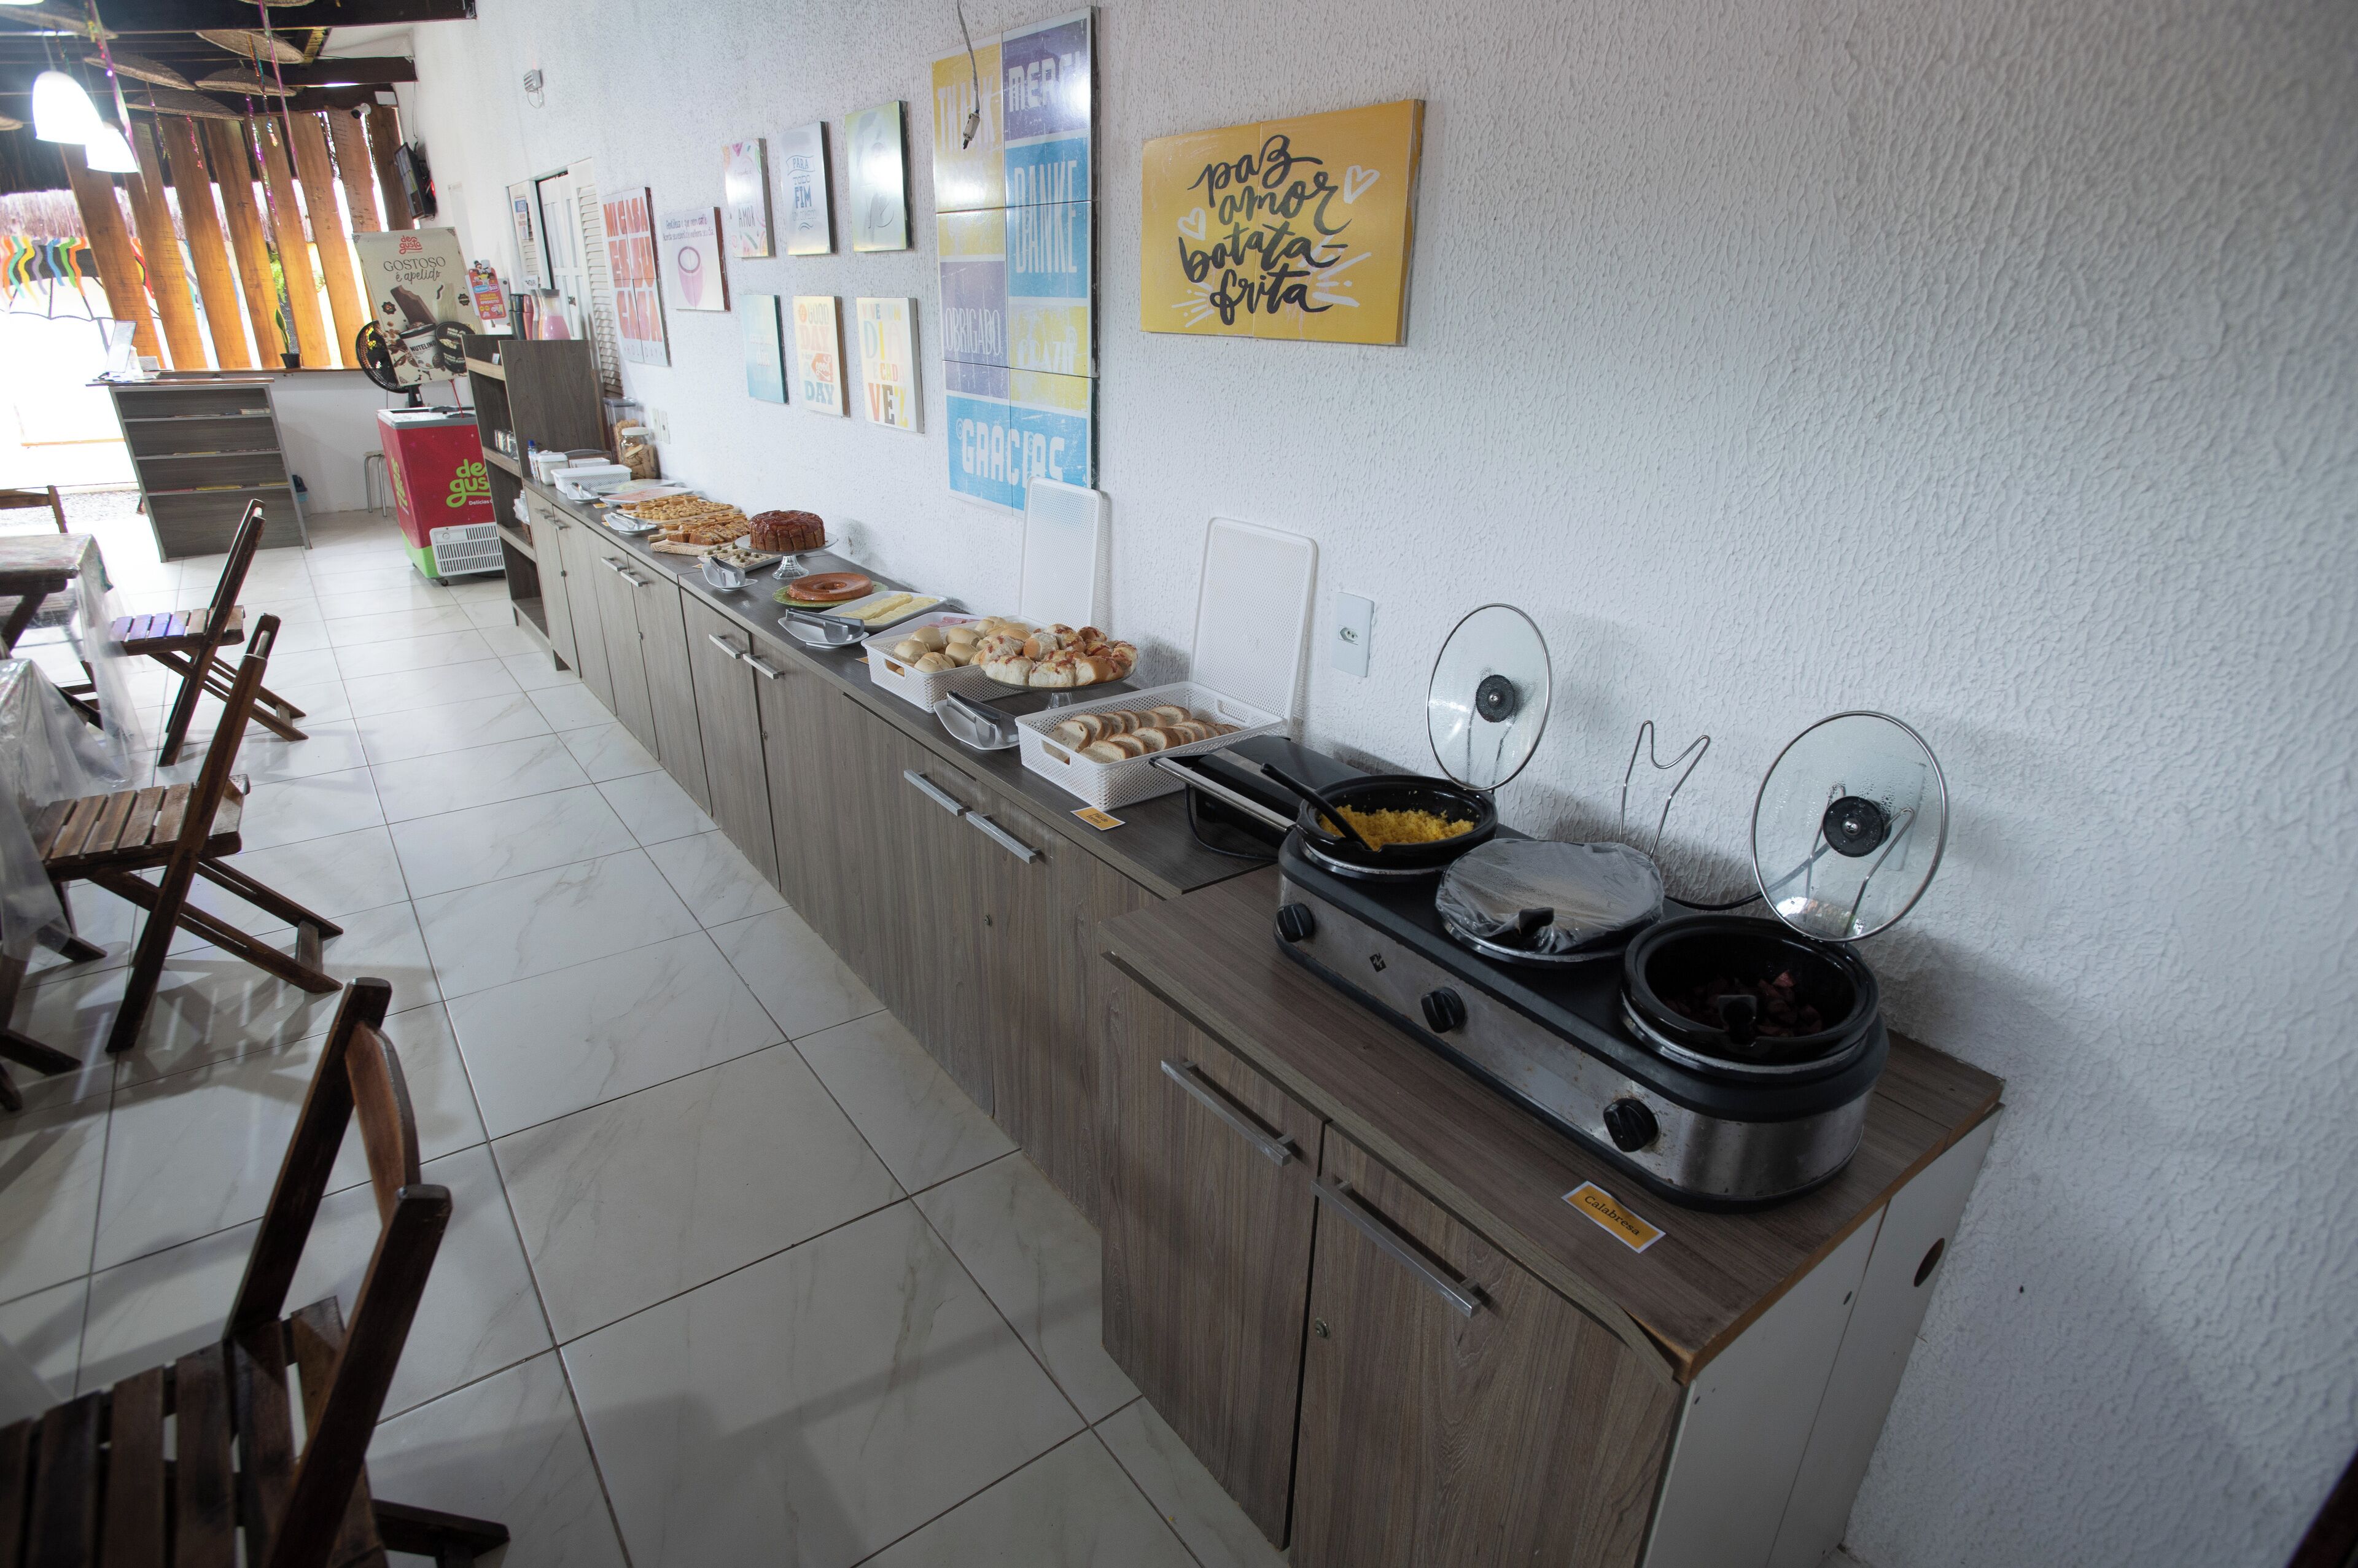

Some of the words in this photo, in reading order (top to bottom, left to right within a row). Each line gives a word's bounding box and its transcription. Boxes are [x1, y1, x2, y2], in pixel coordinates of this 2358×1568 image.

[792, 157, 809, 169] PARA
[792, 174, 811, 185] TODO
[1188, 134, 1323, 208] paz
[794, 185, 812, 209] FIM
[1219, 171, 1352, 236] amor
[617, 196, 649, 235] CASA
[738, 205, 756, 228] AMOR
[1014, 160, 1078, 274] DANKE
[383, 256, 446, 272] GOSTOSO
[395, 271, 402, 282] é
[404, 268, 442, 285] apelido
[1210, 263, 1334, 326] frita
[616, 290, 663, 343] CASA
[807, 303, 830, 325] GOOD
[945, 307, 1002, 356] OBRIGADO
[799, 324, 830, 352] DAY
[863, 320, 905, 363] DIA
[804, 380, 835, 405] DAY
[868, 382, 909, 428] VEZ
[456, 459, 486, 478] de
[961, 418, 1065, 489] GRACIAS
[446, 477, 491, 508] gus
[1584, 1195, 1640, 1236] Calabresa
